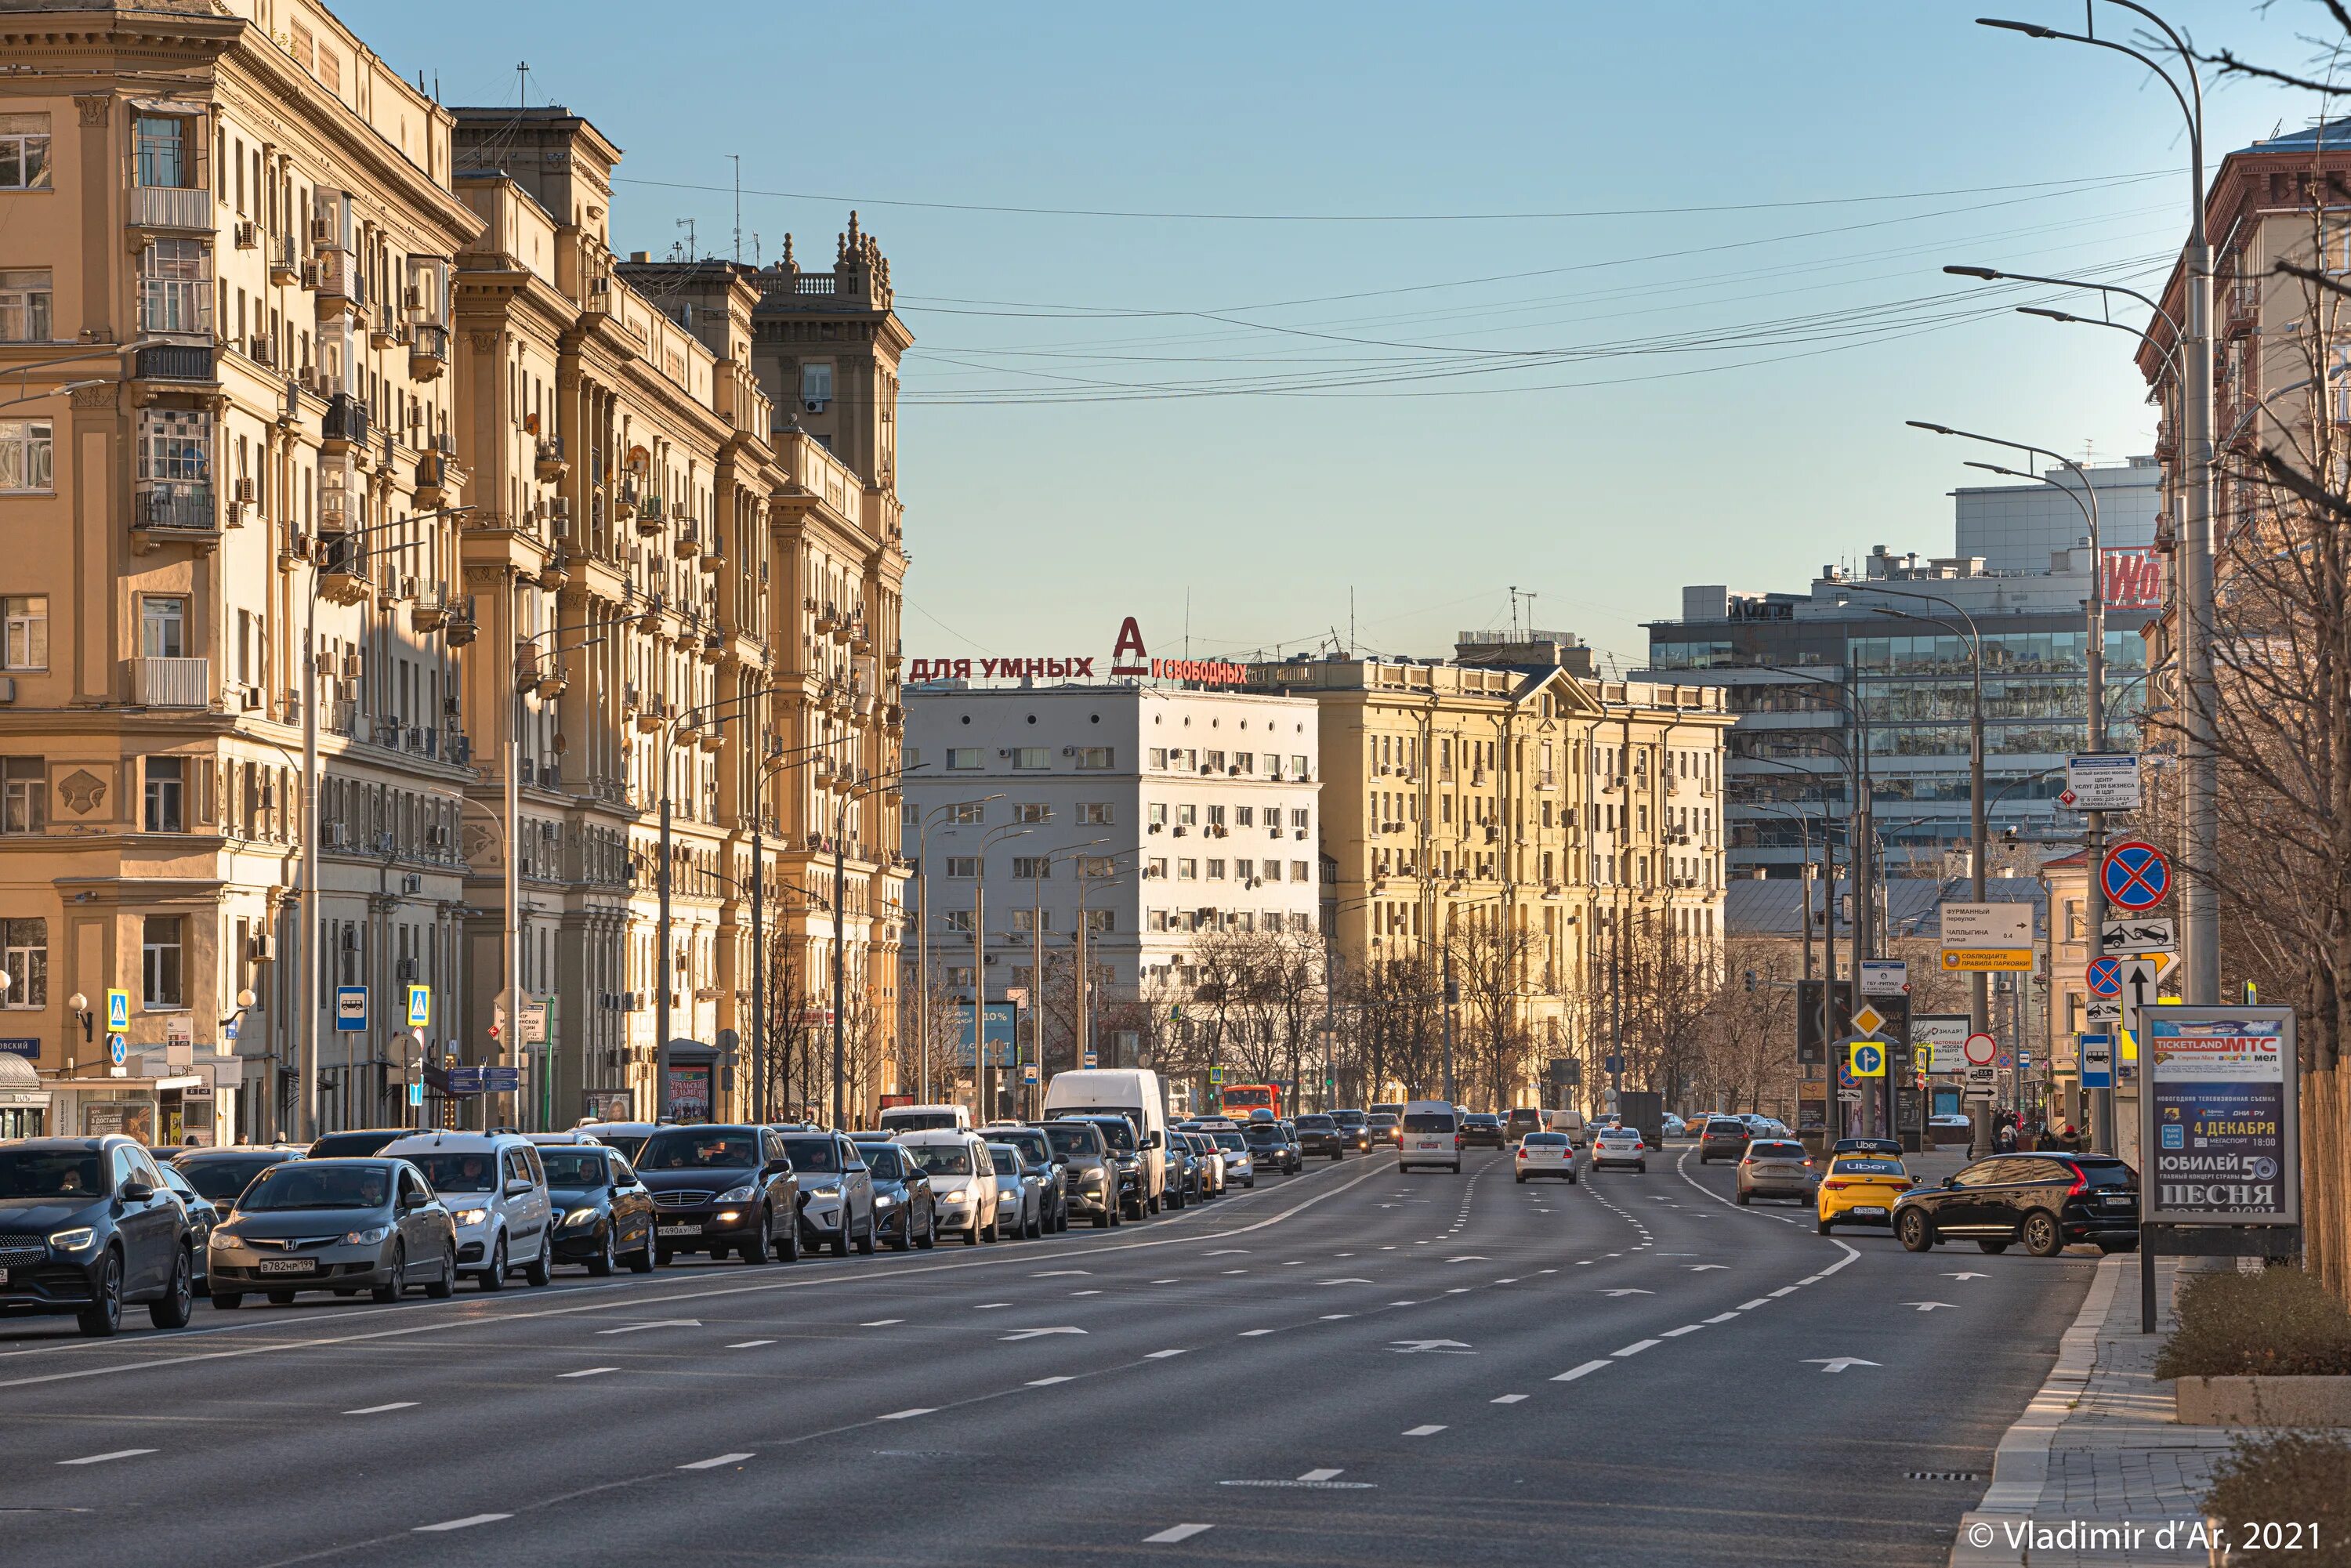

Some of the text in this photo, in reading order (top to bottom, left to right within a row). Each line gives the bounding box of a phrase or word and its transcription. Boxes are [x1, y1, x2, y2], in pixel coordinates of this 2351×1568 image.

[1112, 616, 1147, 657] А
[909, 657, 1095, 683] ДЛЯ УМНЫХ
[1151, 657, 1248, 686] И СВОБОДНЫХ
[2157, 1041, 2222, 1049] TICKETLAND
[2226, 1037, 2277, 1052] МТС
[670, 1079, 707, 1089] УРАЛЬСКИЕ
[670, 1089, 707, 1099] ПЕЛЬМЕНИ
[2194, 1121, 2276, 1137] 4 ДЕКАБРЯ
[1856, 1140, 1878, 1149] Uber
[2253, 1138, 2276, 1146] 18:00
[2159, 1153, 2239, 1171] ЮБИЛЕЙ
[2160, 1184, 2275, 1204] ПЕСНЯ
[263, 1262, 298, 1271] В782НР
